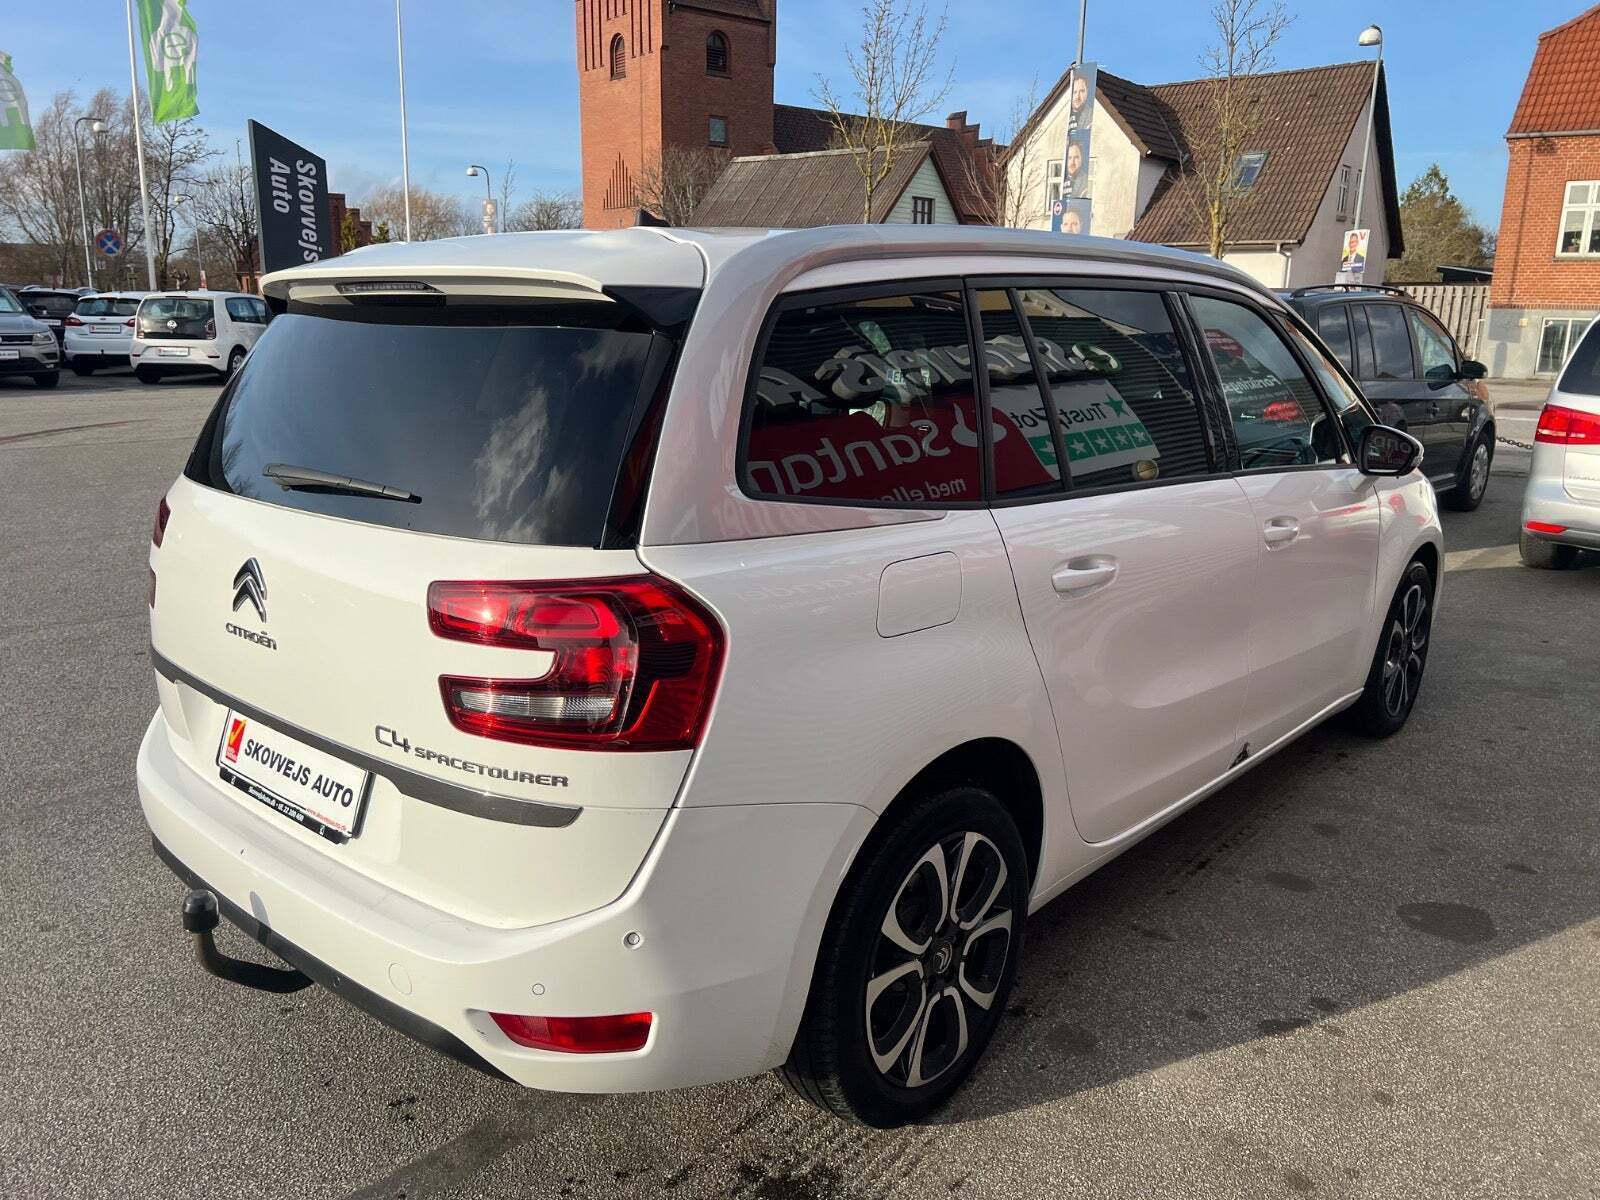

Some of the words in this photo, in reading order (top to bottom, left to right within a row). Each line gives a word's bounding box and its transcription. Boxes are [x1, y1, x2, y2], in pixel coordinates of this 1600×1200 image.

[269, 156, 293, 214] Auto
[296, 159, 322, 263] Skovvejs
[244, 738, 311, 786] SKOVVEJS
[311, 773, 354, 808] AUTO
[375, 724, 411, 753] C4
[414, 746, 569, 787] SPACETOURER
